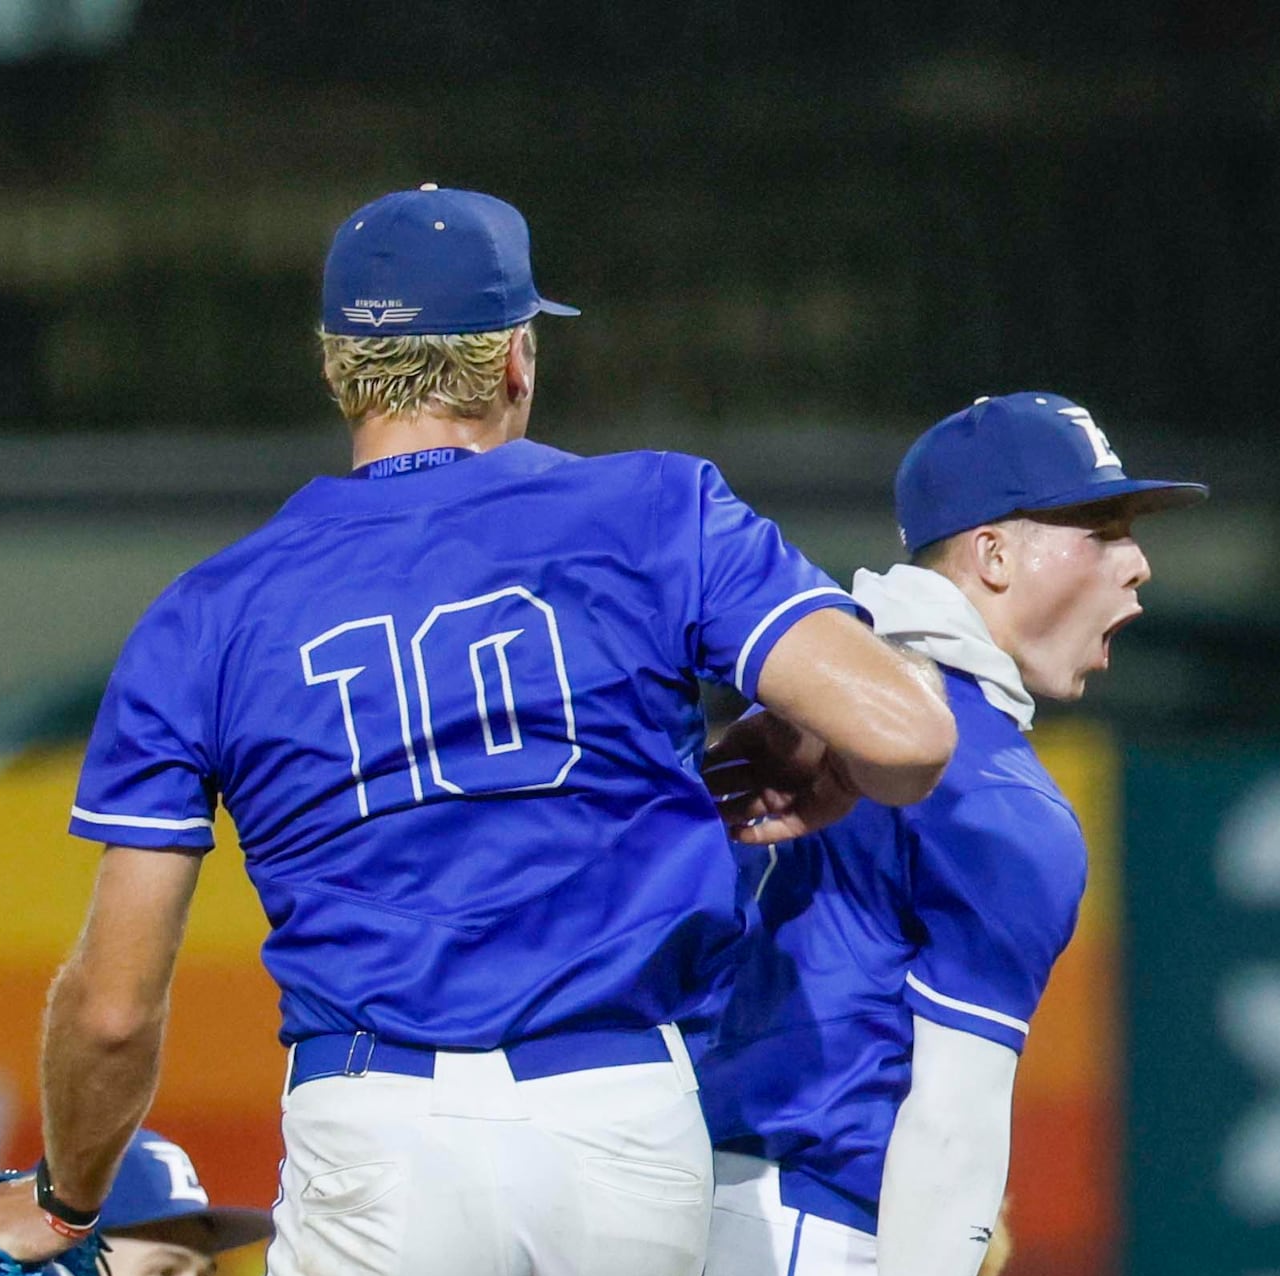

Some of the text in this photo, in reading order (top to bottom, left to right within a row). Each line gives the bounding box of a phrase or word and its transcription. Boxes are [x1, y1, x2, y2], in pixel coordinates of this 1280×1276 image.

[370, 449, 455, 478] NIKE PRO
[299, 585, 582, 817] 10
